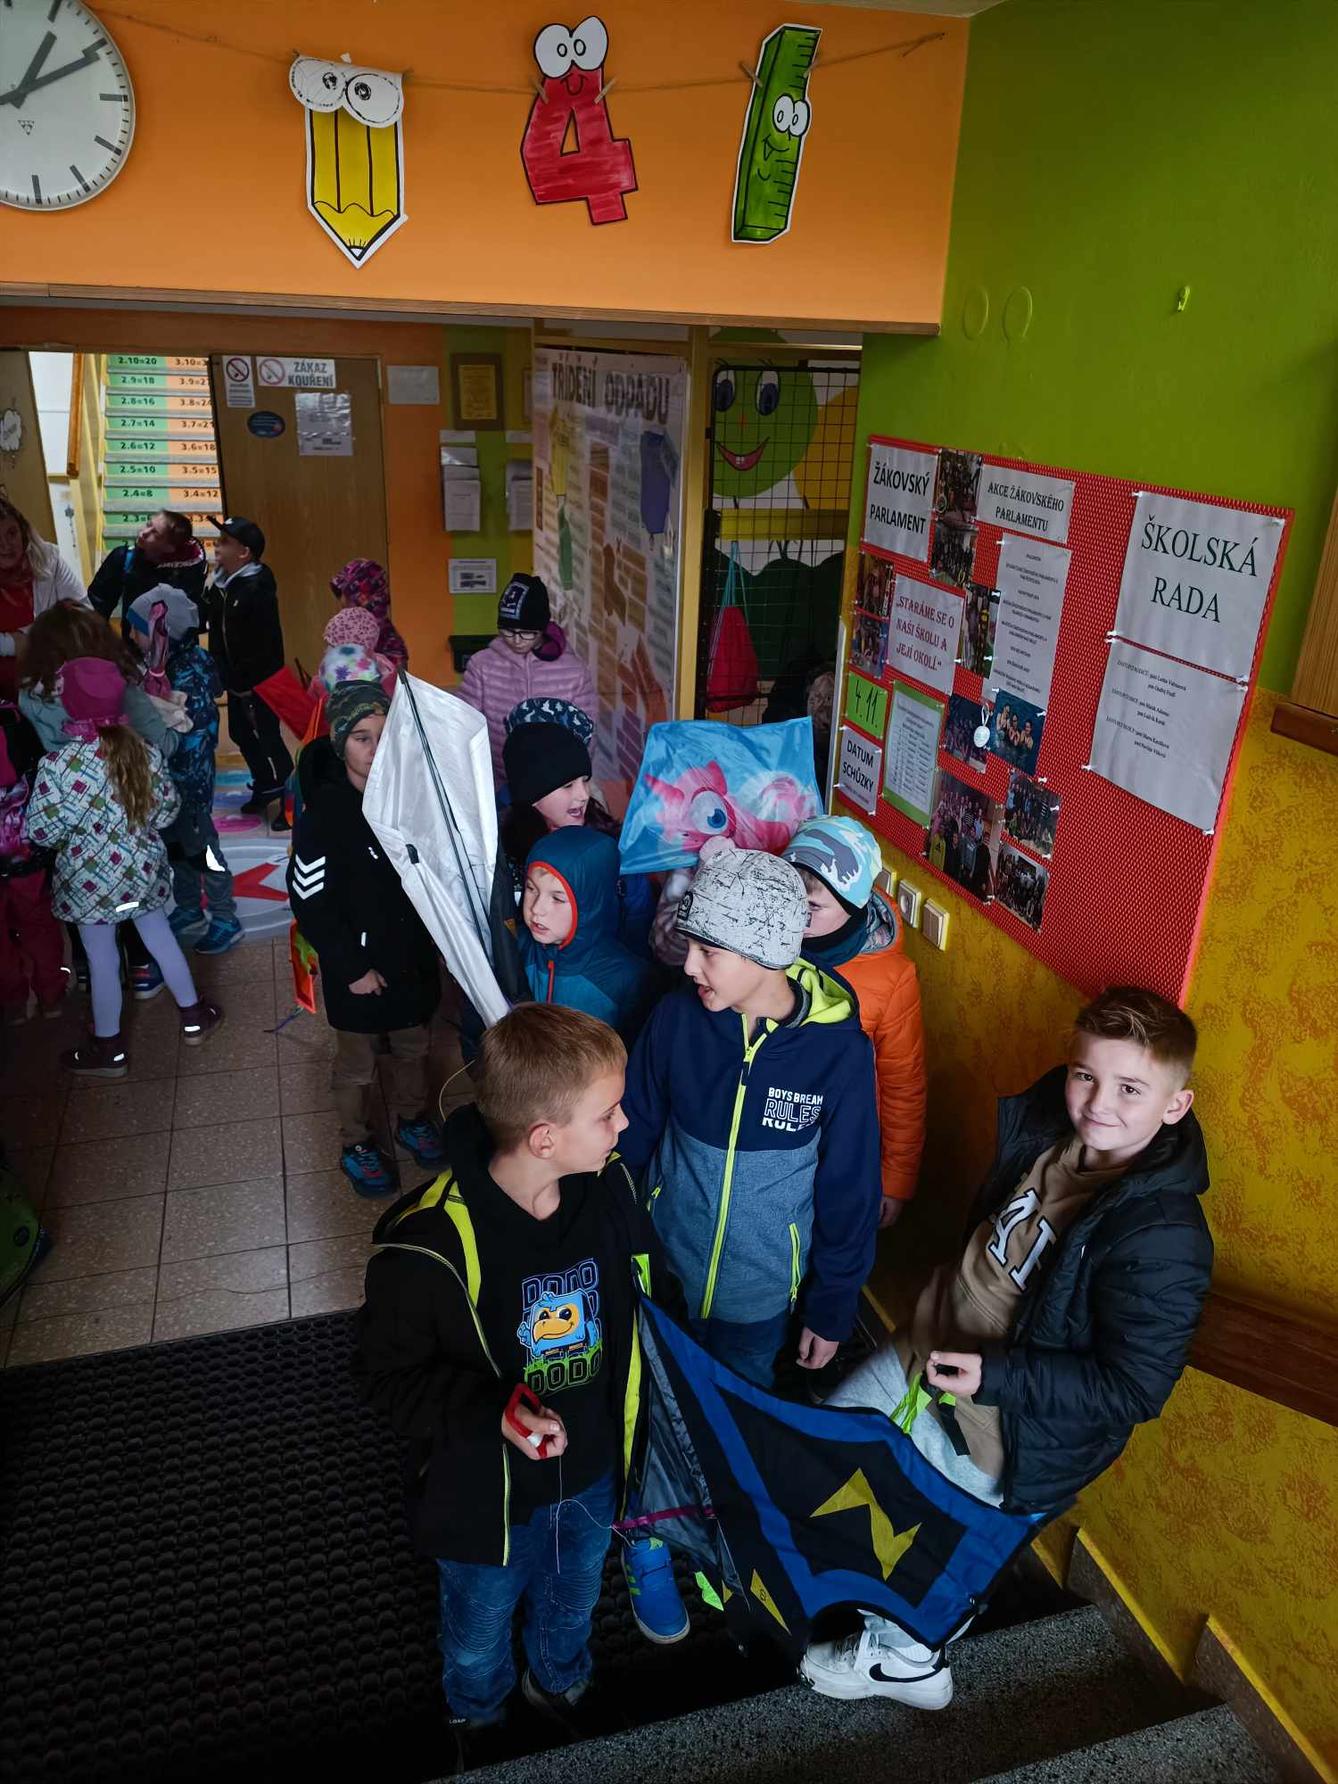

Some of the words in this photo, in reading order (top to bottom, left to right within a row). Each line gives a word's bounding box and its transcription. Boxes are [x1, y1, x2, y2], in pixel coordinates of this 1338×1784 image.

[287, 373, 334, 387] KOUŘENÍ
[293, 359, 328, 374] ZÁKAZ
[604, 371, 671, 426] ODPADU
[873, 461, 930, 496] ŽÁKOVSKÝ
[987, 482, 1009, 501] AKCE
[1009, 483, 1065, 512] ŽÁKOVSKÉHO
[869, 504, 927, 534] PARLAMENT
[995, 505, 1050, 532] PARLAMENTU
[1141, 514, 1259, 577] ŠKOLSKÁ
[1151, 576, 1221, 624] RADA
[935, 609, 948, 626] SE
[948, 615, 956, 629] O
[896, 617, 914, 637] NAŠI
[912, 623, 941, 648] ŠKOLU
[940, 638, 948, 652] A
[896, 642, 912, 659] JEJÍ
[846, 740, 874, 769] DATUM
[842, 761, 875, 793] SCHŮZKY
[768, 1086, 793, 1102] BOYS
[763, 1097, 822, 1124] RULES
